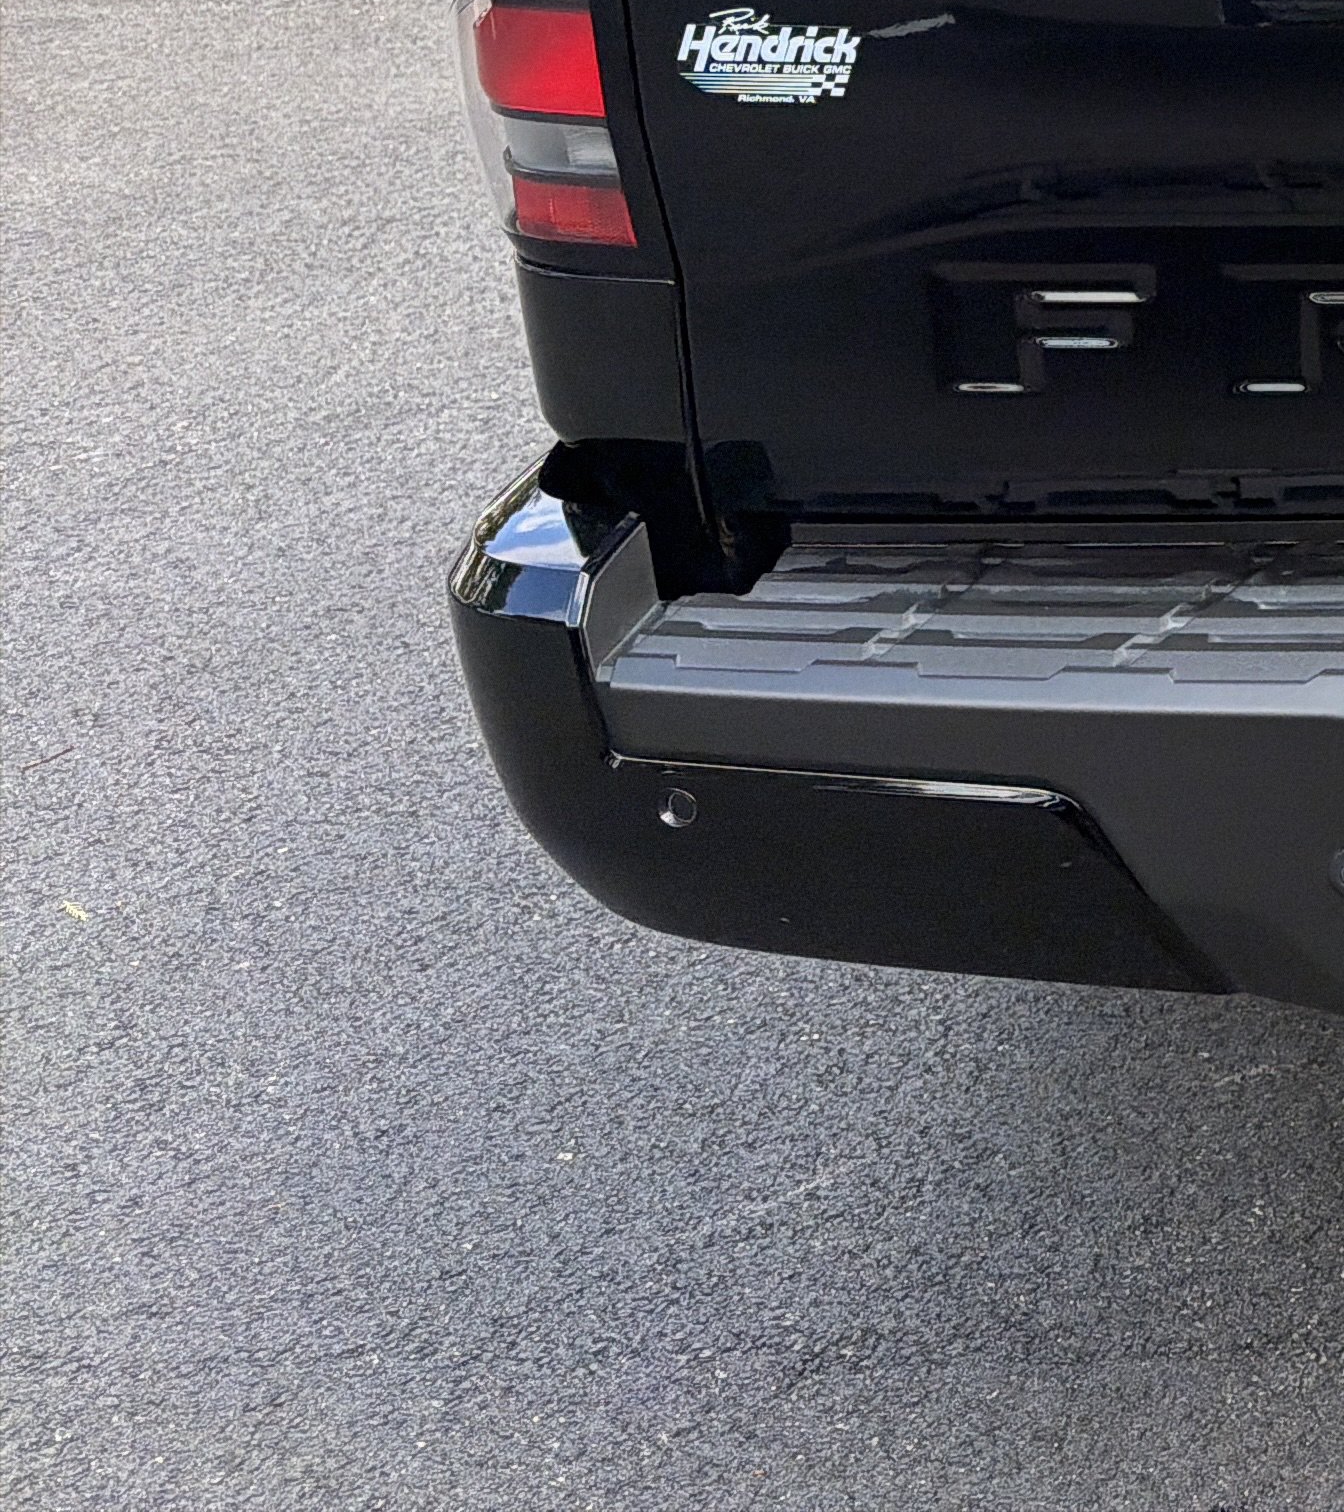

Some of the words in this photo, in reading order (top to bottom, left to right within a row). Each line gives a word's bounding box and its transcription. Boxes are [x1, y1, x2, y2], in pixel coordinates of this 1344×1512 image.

[677, 23, 860, 72] Hendrick
[709, 62, 780, 73] CHEVROLET
[782, 63, 819, 74] BUICK
[823, 64, 852, 75] GMC
[799, 93, 816, 104] VA
